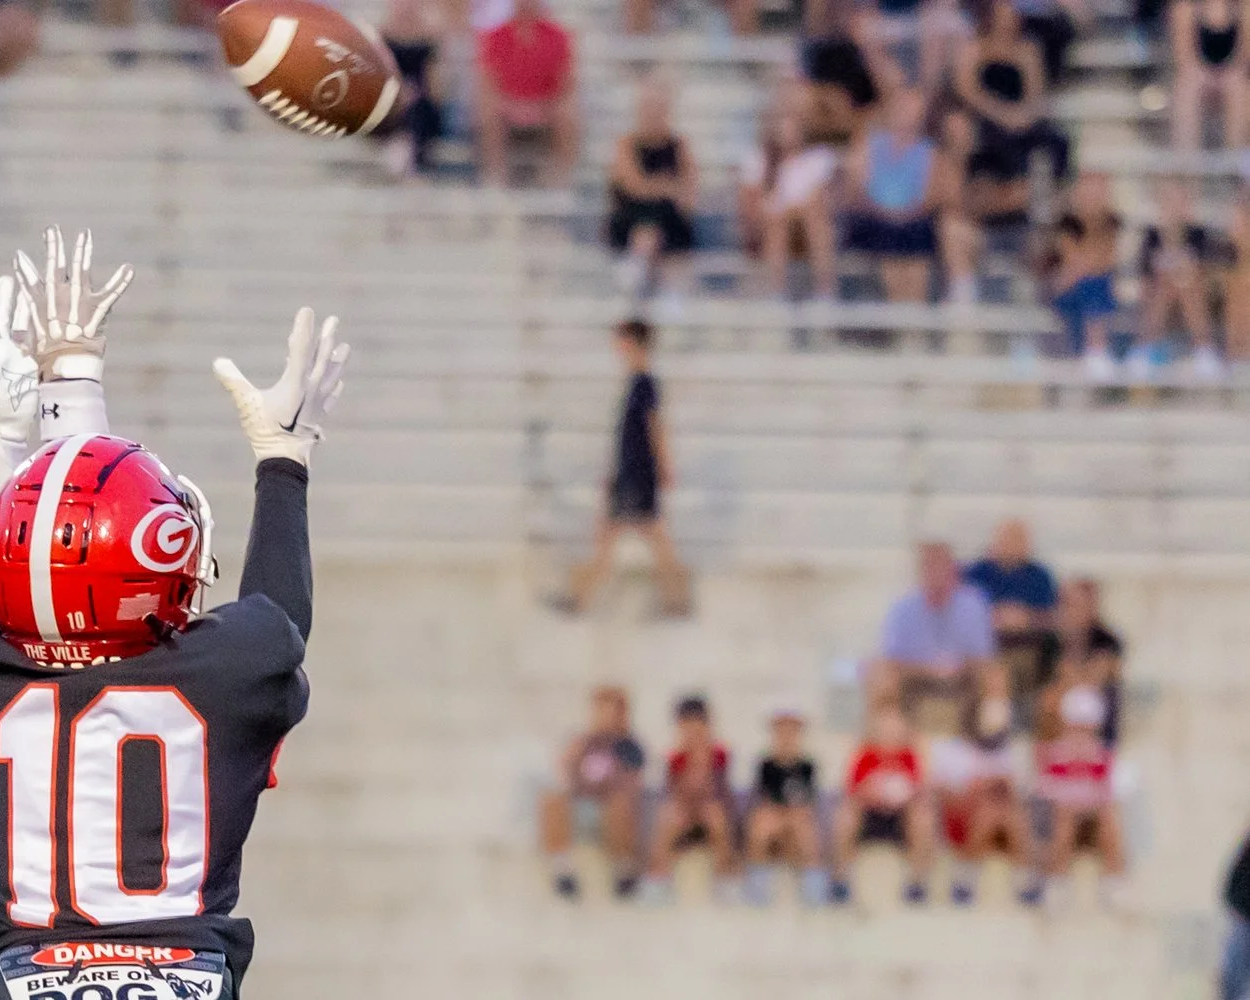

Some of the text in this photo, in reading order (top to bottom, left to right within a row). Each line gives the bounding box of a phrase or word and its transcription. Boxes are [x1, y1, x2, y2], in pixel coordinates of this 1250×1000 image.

[66, 611, 86, 630] 10
[22, 643, 92, 661] THE VILLE
[53, 943, 174, 963] DANGER
[27, 970, 119, 992] BEWARE
